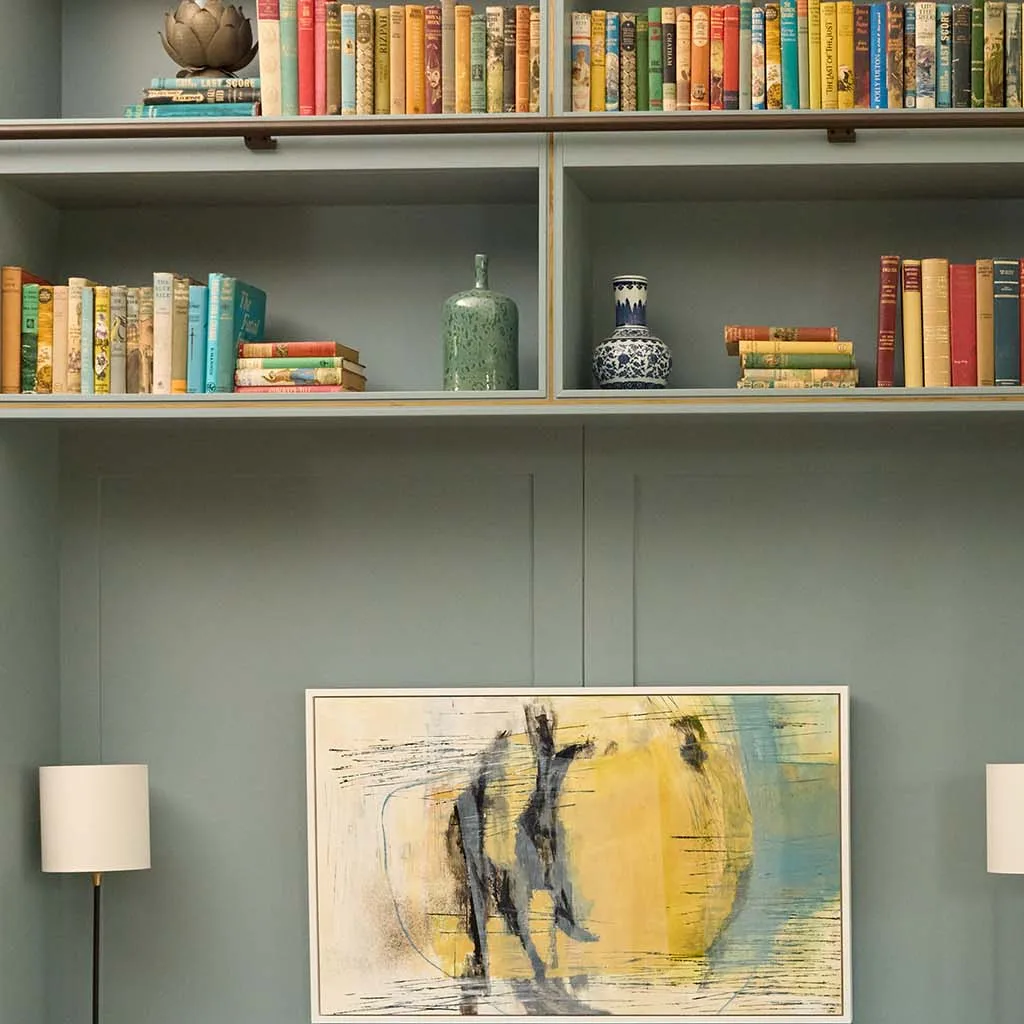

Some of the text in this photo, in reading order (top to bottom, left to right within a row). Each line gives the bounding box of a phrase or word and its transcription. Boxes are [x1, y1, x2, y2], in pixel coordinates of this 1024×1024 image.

[379, 15, 388, 54] RIZPAH
[940, 11, 949, 41] SCORE
[941, 45, 949, 66] LAST
[225, 78, 256, 88] SCORE
